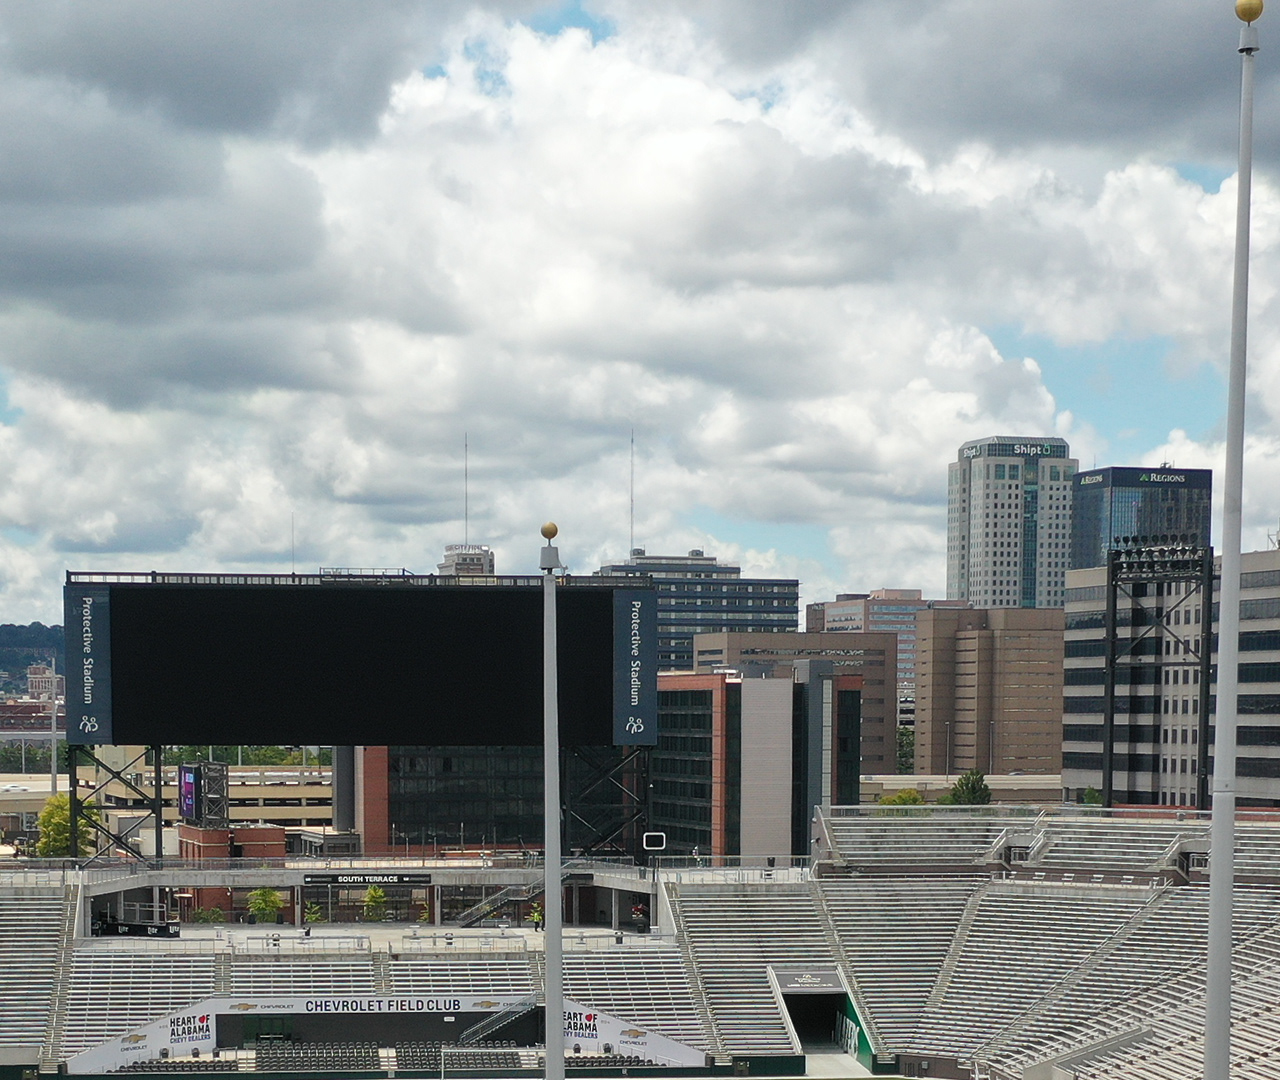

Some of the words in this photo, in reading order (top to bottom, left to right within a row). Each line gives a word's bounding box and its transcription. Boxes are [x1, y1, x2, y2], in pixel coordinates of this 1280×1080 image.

[1014, 444, 1041, 456] Shipt
[1150, 473, 1185, 483] REGIONS
[82, 597, 94, 654] Protective
[631, 601, 642, 656] Protective
[83, 658, 95, 704] Stadium
[631, 660, 641, 706] Stadium
[305, 1000, 384, 1012] CHEVROLET
[387, 999, 424, 1011] FIELD
[427, 999, 461, 1011] CLUB
[170, 1015, 197, 1028] HEART
[563, 1011, 583, 1021] EART
[170, 1024, 210, 1038] ALABAMA
[563, 1020, 598, 1033] LABAMA
[170, 1036, 187, 1044] CHEVY
[188, 1034, 211, 1042] DEALERS
